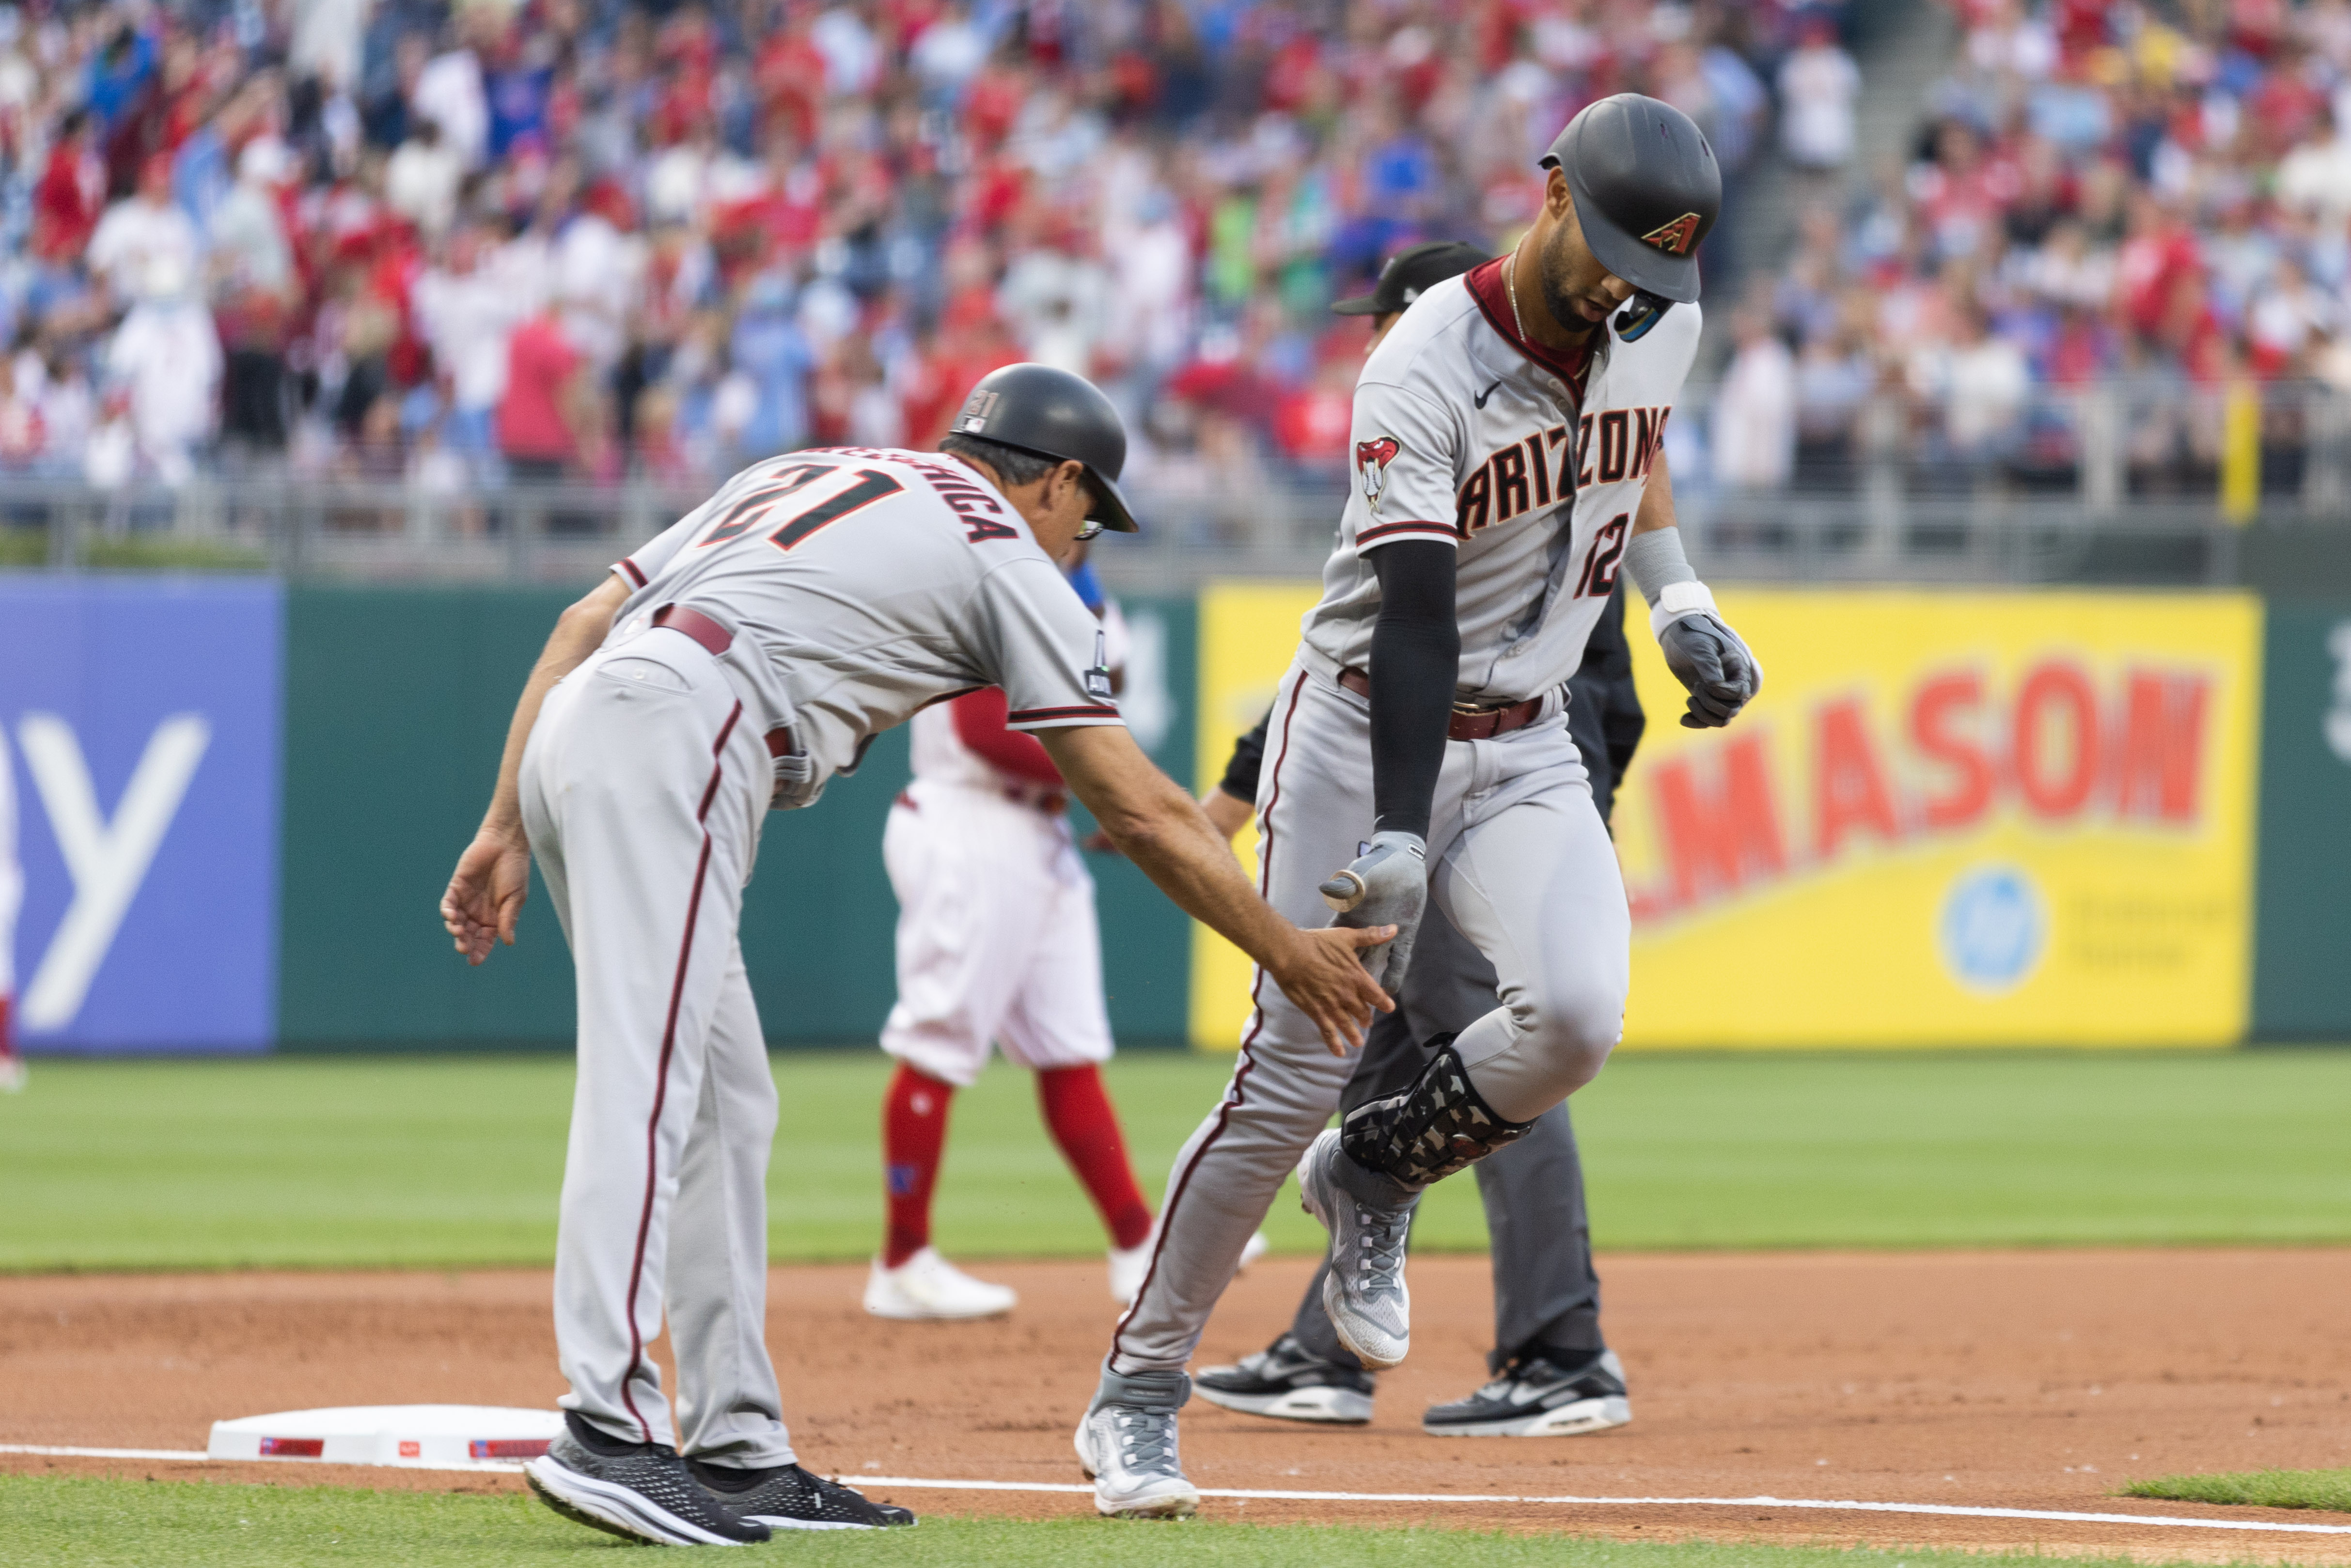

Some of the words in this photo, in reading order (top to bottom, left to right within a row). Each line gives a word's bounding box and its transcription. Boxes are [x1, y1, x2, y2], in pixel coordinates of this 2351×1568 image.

[968, 390, 1000, 418] 21
[694, 463, 910, 554] 21
[1455, 405, 1672, 542] ARIZON
[1573, 512, 1629, 599] 12
